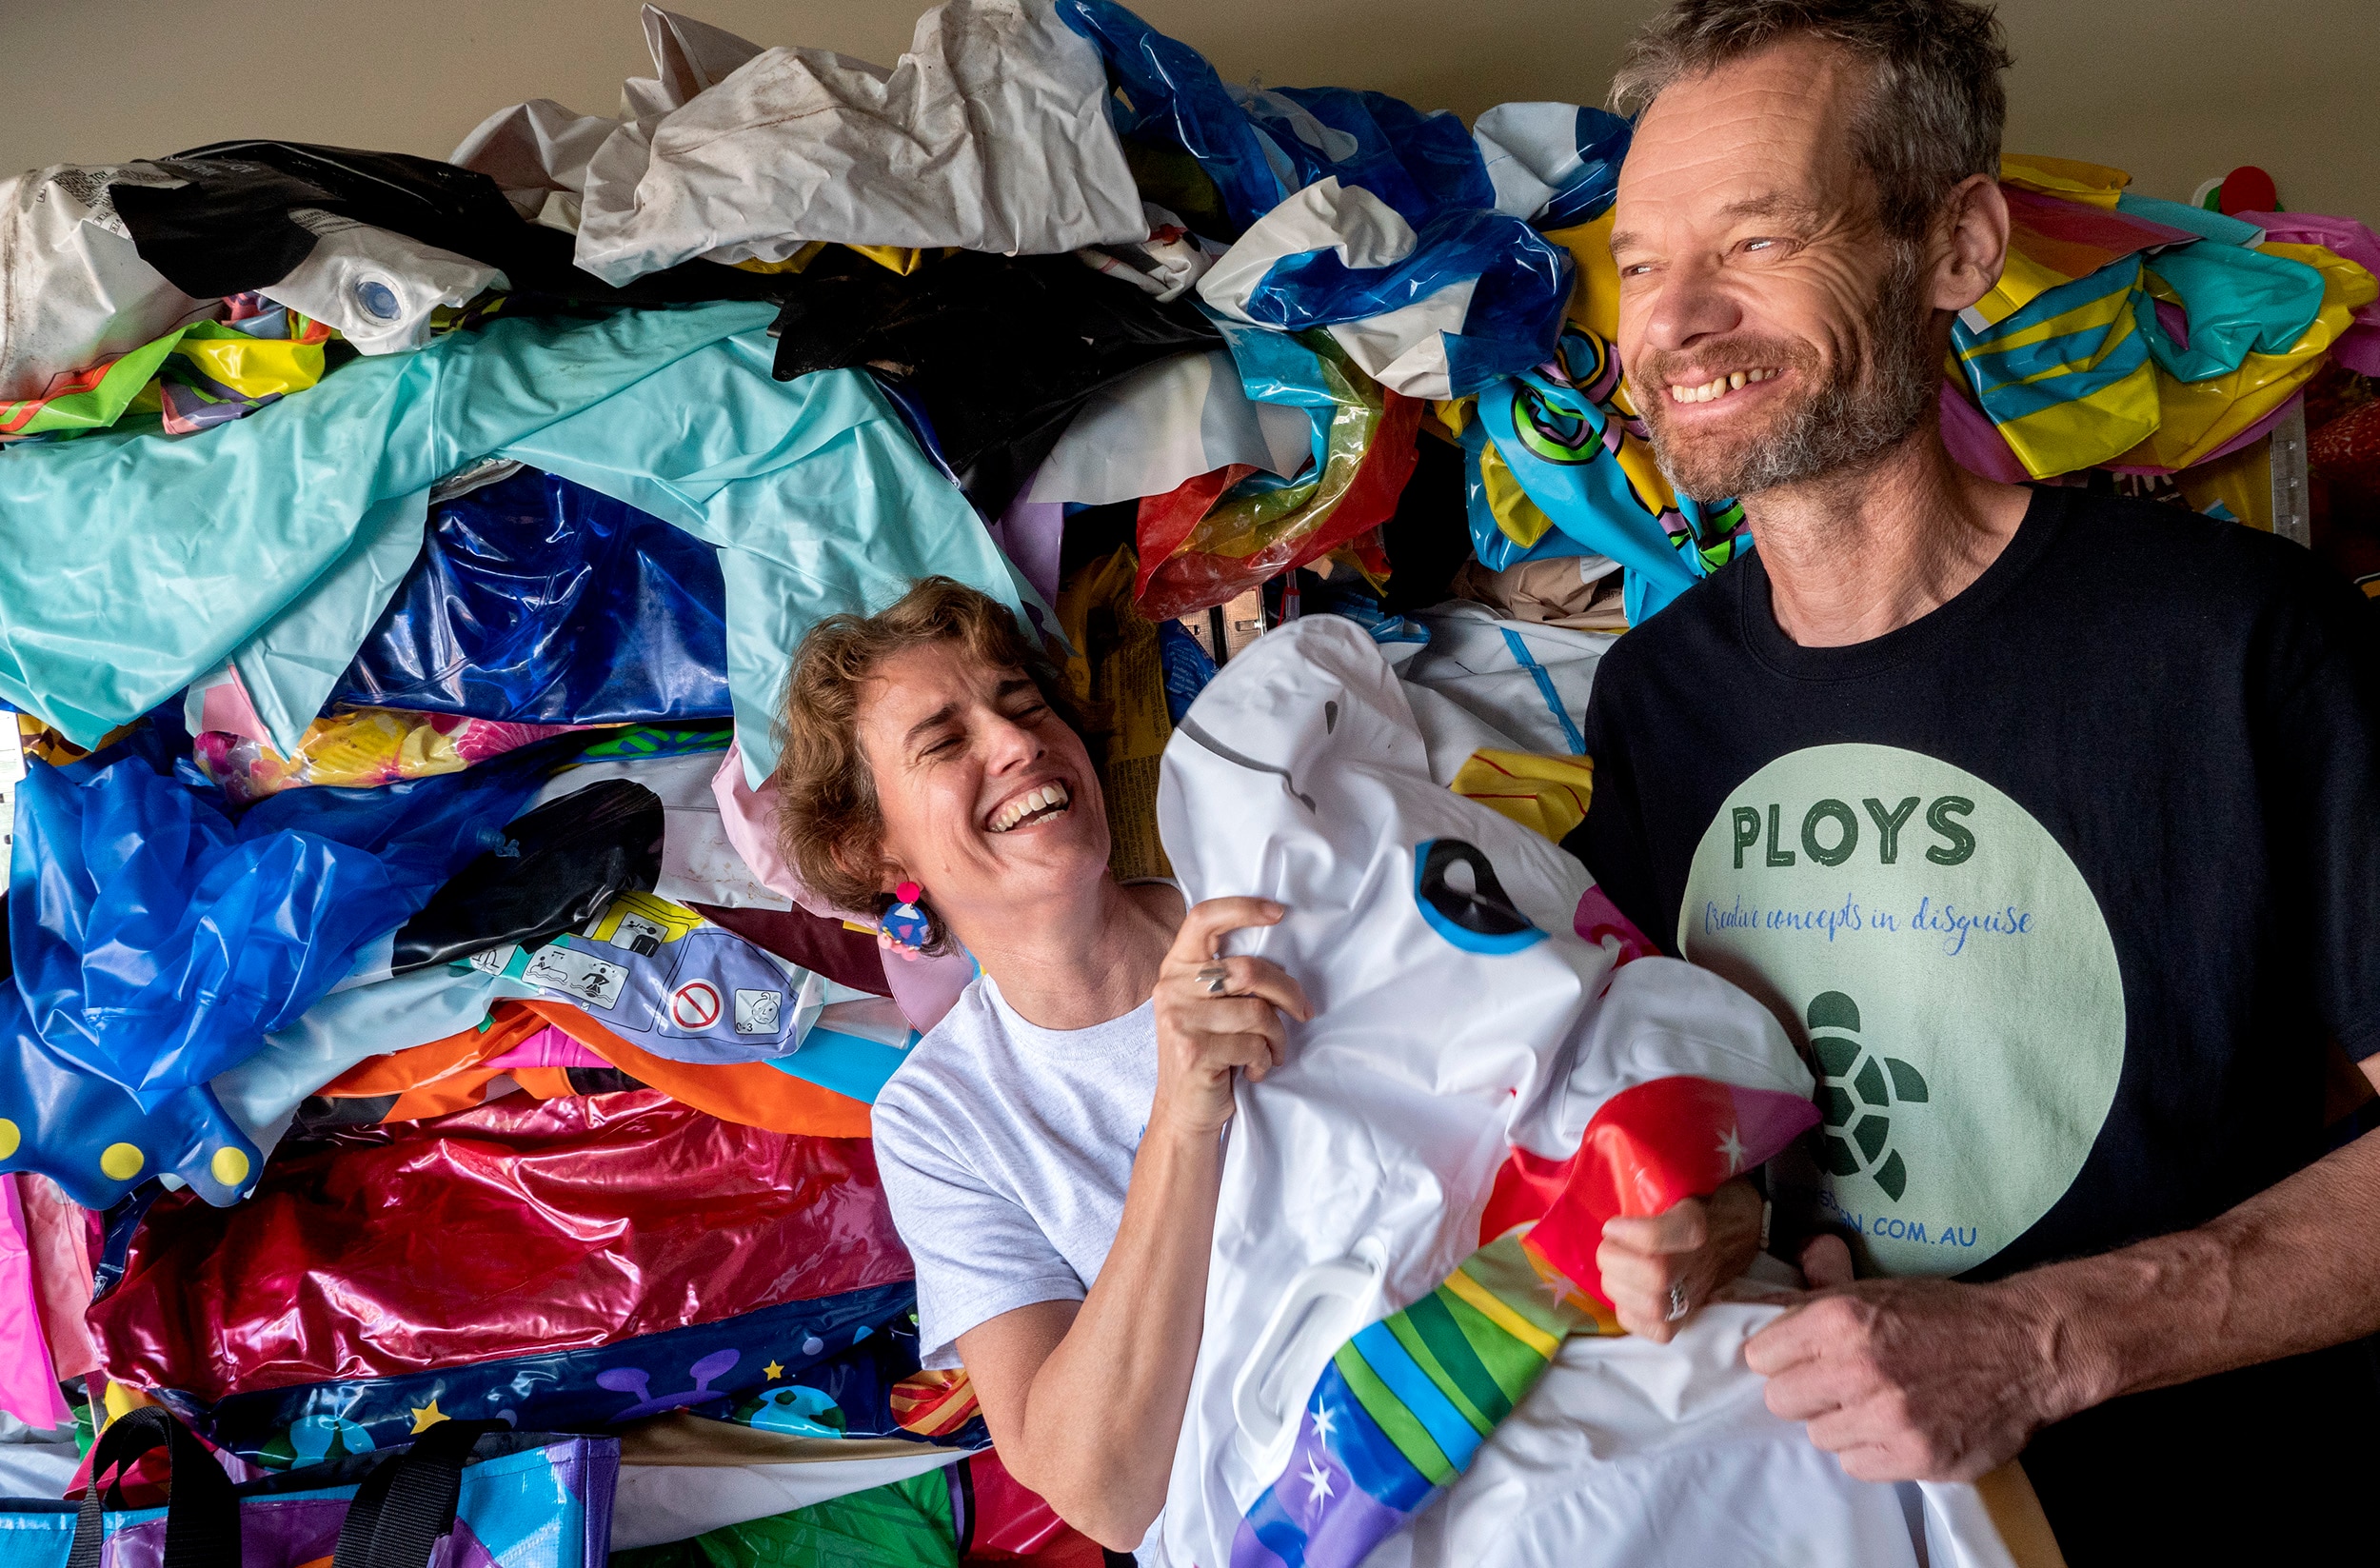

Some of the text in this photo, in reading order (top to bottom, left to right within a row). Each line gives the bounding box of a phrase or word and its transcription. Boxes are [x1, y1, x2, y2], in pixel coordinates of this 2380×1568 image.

[1732, 796, 1976, 870] PLOYS
[1705, 892, 2036, 957] Creative concepts in disguise
[737, 1022, 753, 1032] 0-3
